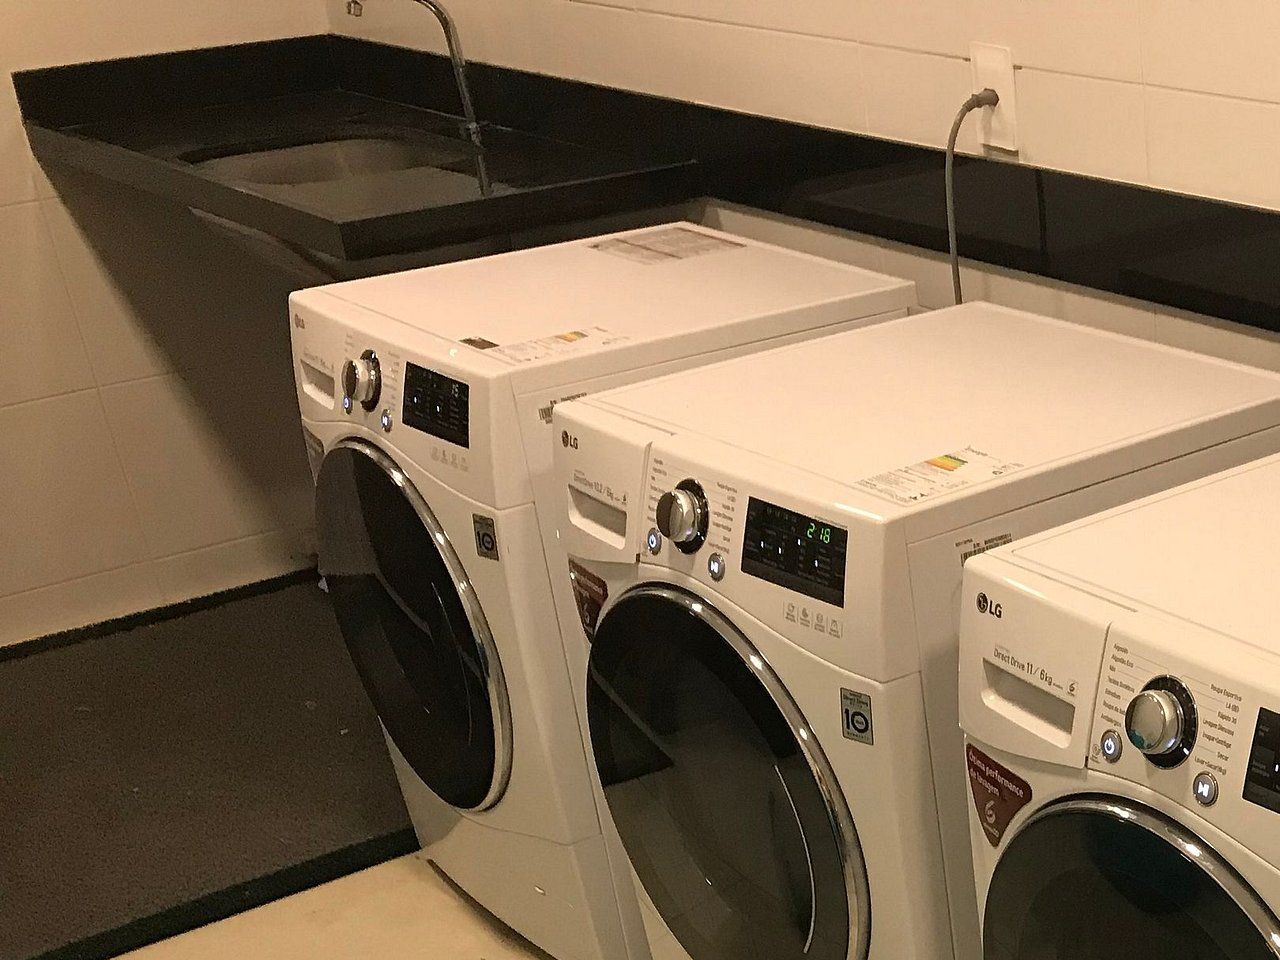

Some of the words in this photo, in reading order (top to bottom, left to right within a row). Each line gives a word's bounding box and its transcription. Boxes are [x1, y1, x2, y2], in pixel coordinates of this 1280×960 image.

[569, 435, 578, 449] LG
[988, 600, 1002, 618] LG
[993, 648, 1010, 664] Direct
[1010, 655, 1025, 671] Drive
[844, 708, 869, 733] 10
